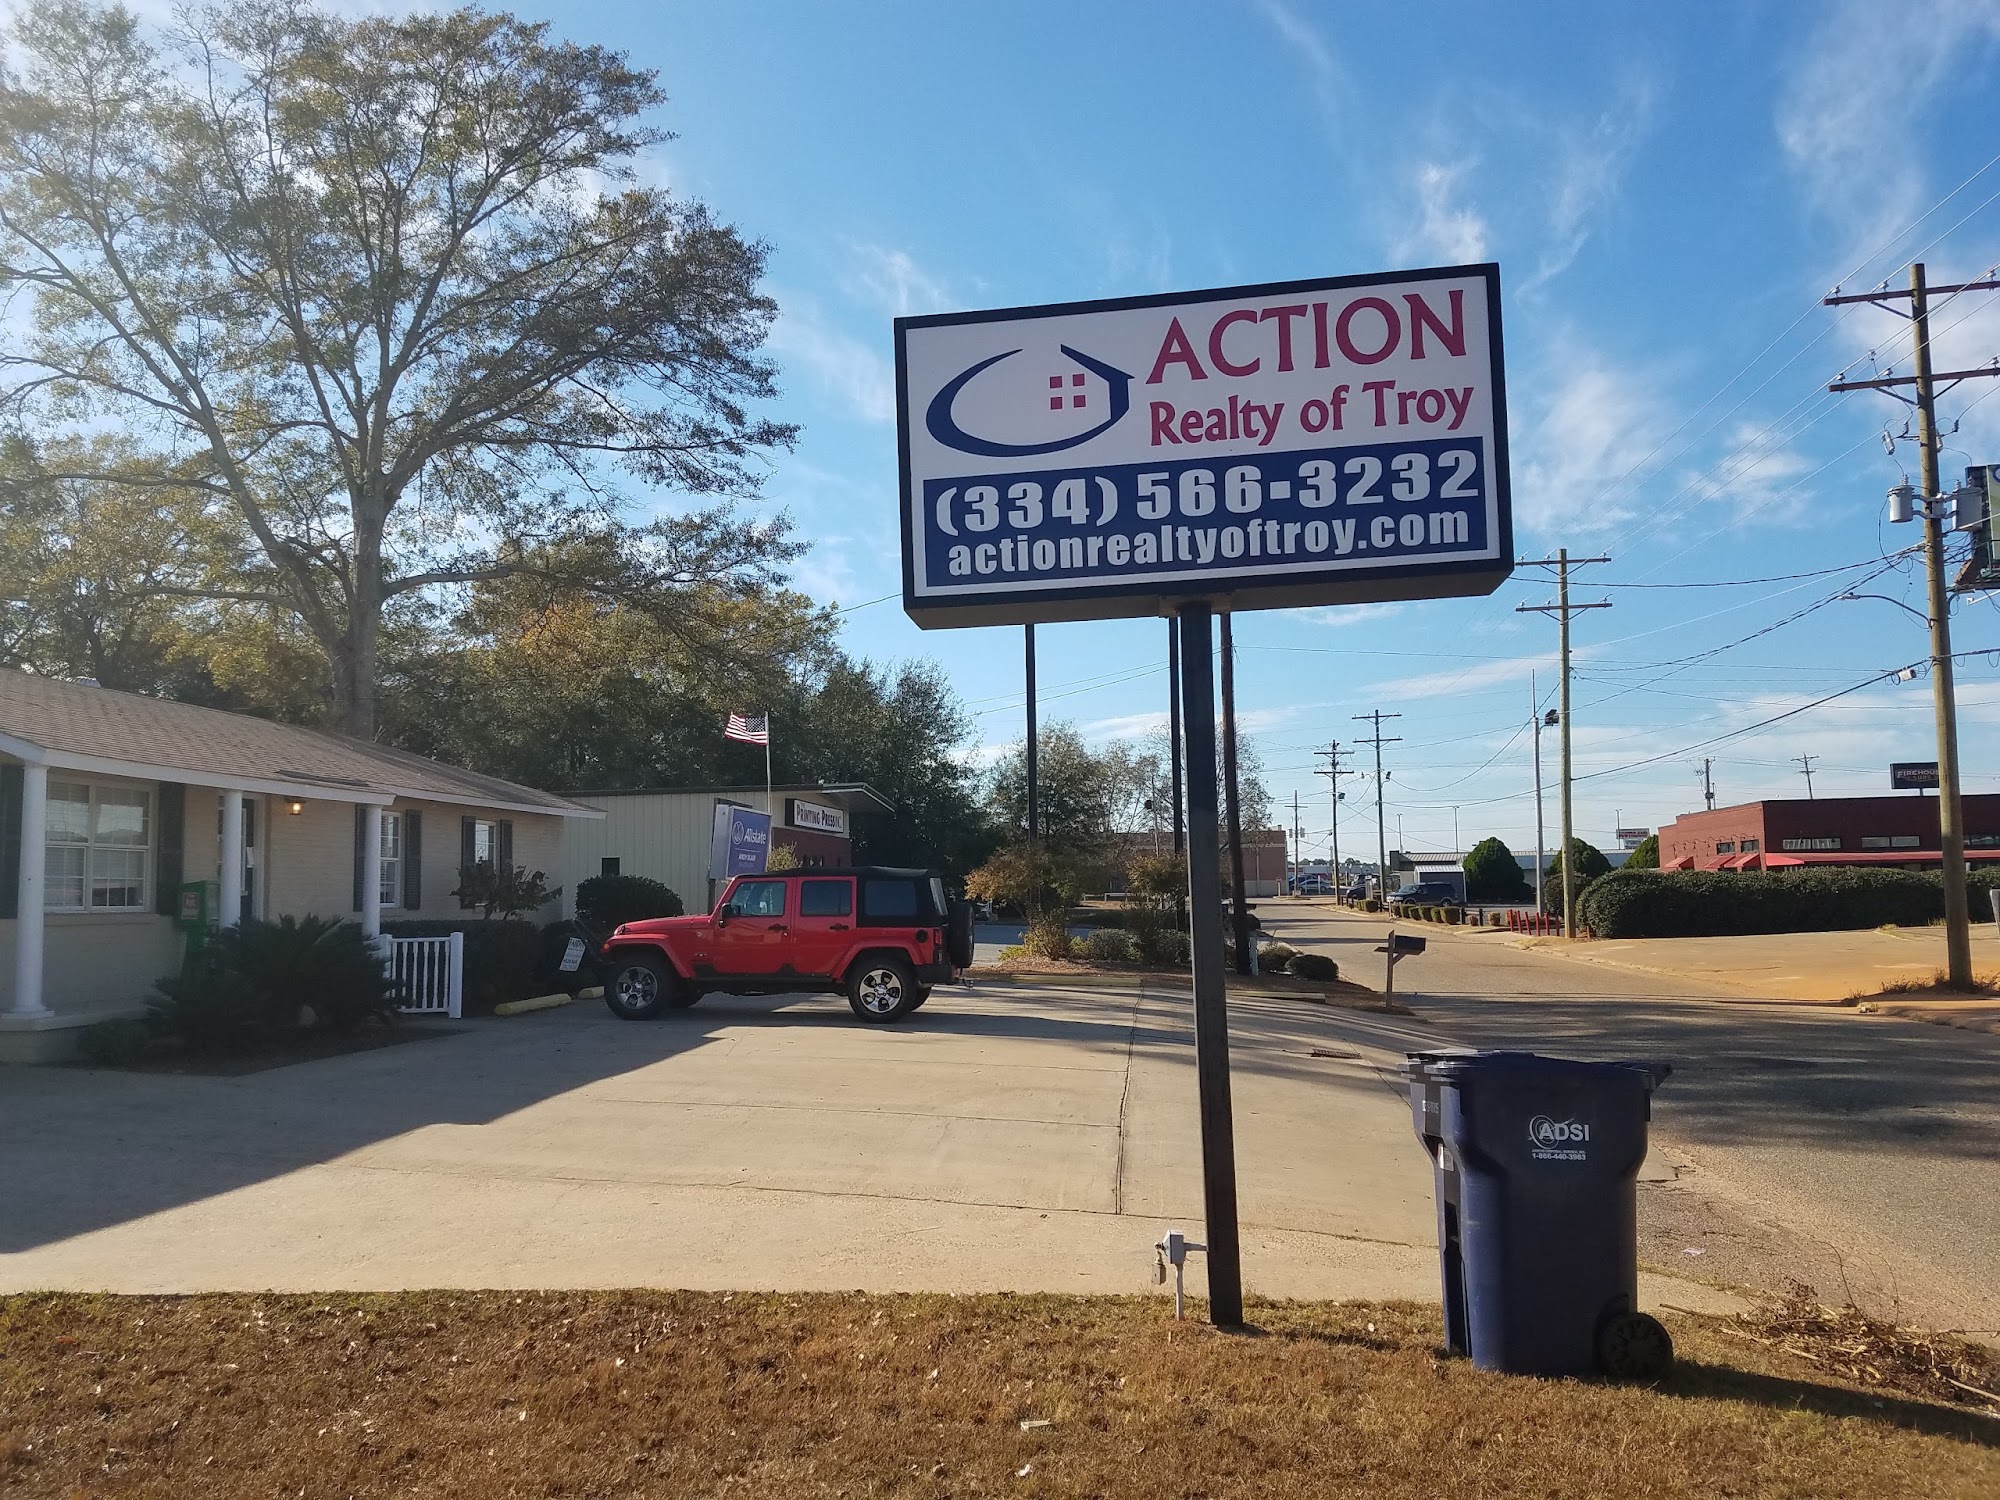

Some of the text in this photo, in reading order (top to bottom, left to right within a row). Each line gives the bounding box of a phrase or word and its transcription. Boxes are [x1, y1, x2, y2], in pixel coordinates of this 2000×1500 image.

[1146, 289, 1467, 384] ACTION
[1150, 380, 1474, 446] Realty of Troy
[936, 449, 1479, 537] (334) 566-3232
[948, 510, 1469, 576] actionrealtyoftroy.com
[1897, 770, 1939, 778] FIREHOUS
[796, 803, 821, 825] PRINTING
[743, 828, 767, 845] Allstate
[1539, 1123, 1590, 1141] ADSI
